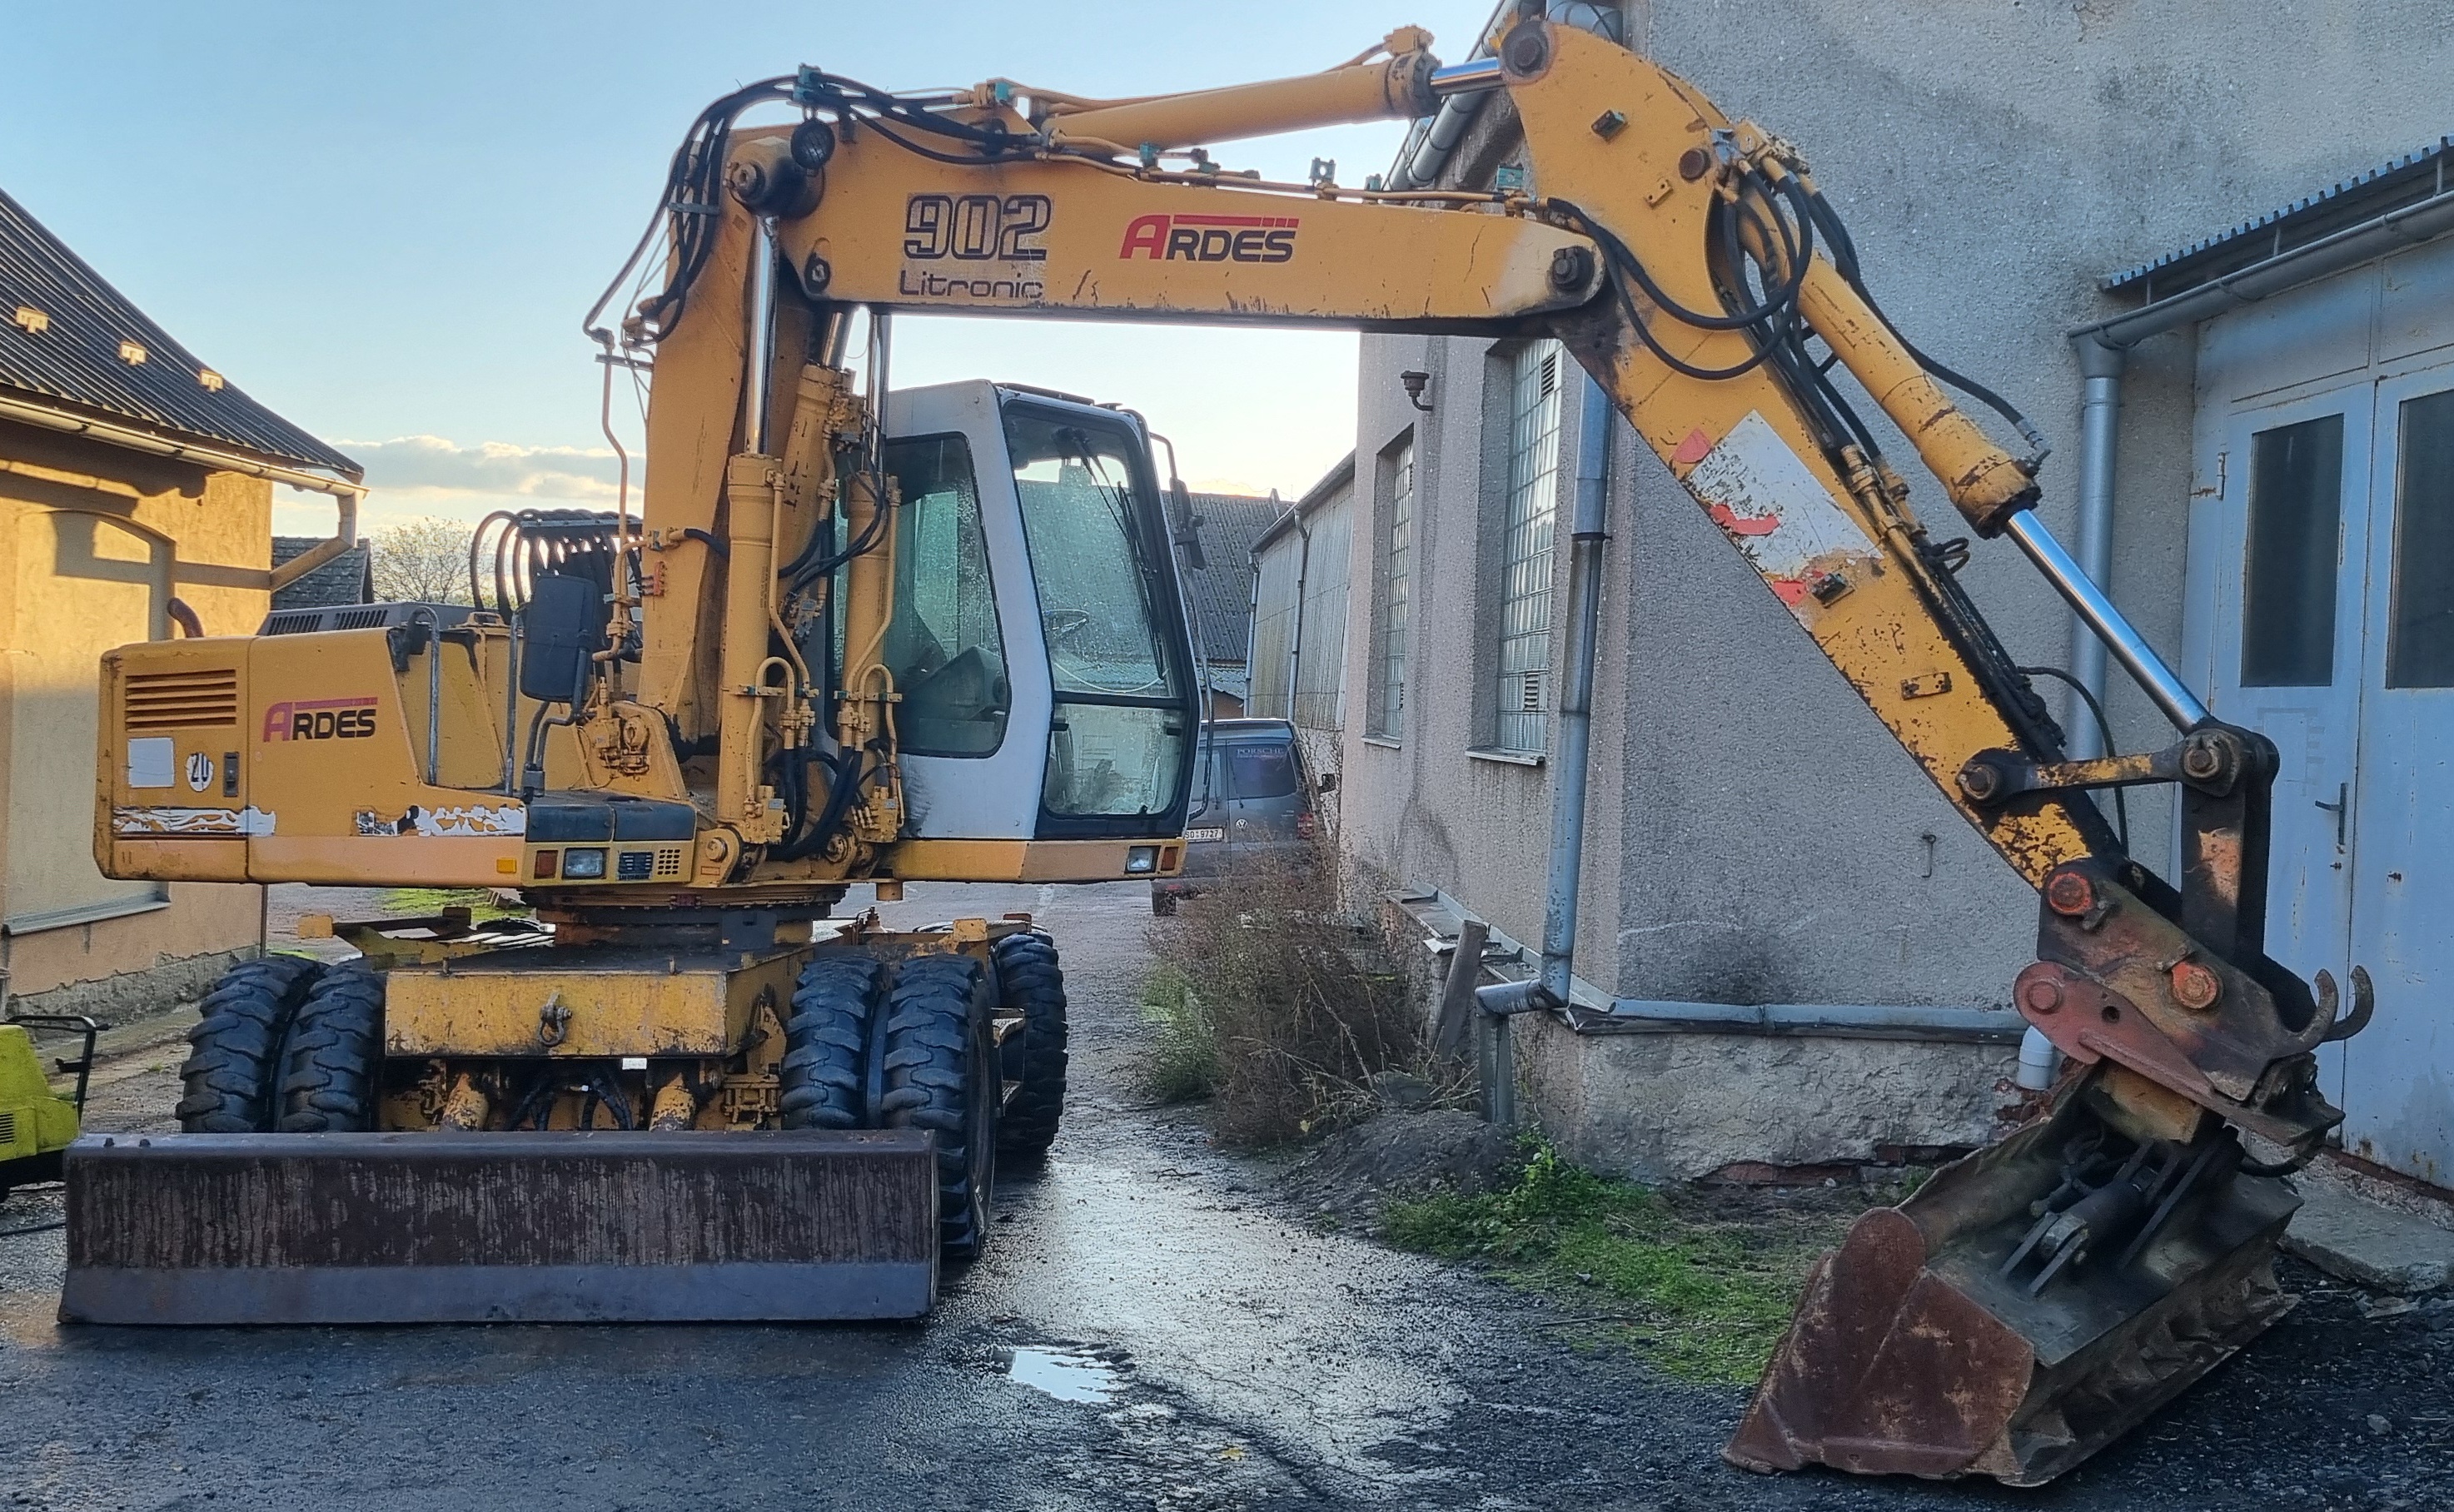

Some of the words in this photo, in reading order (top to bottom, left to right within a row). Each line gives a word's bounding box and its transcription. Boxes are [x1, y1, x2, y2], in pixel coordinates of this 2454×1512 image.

[904, 194, 1052, 261] 902
[1118, 214, 1297, 263] ARDES
[899, 269, 1043, 299] Litronic
[262, 701, 377, 743] ARDES
